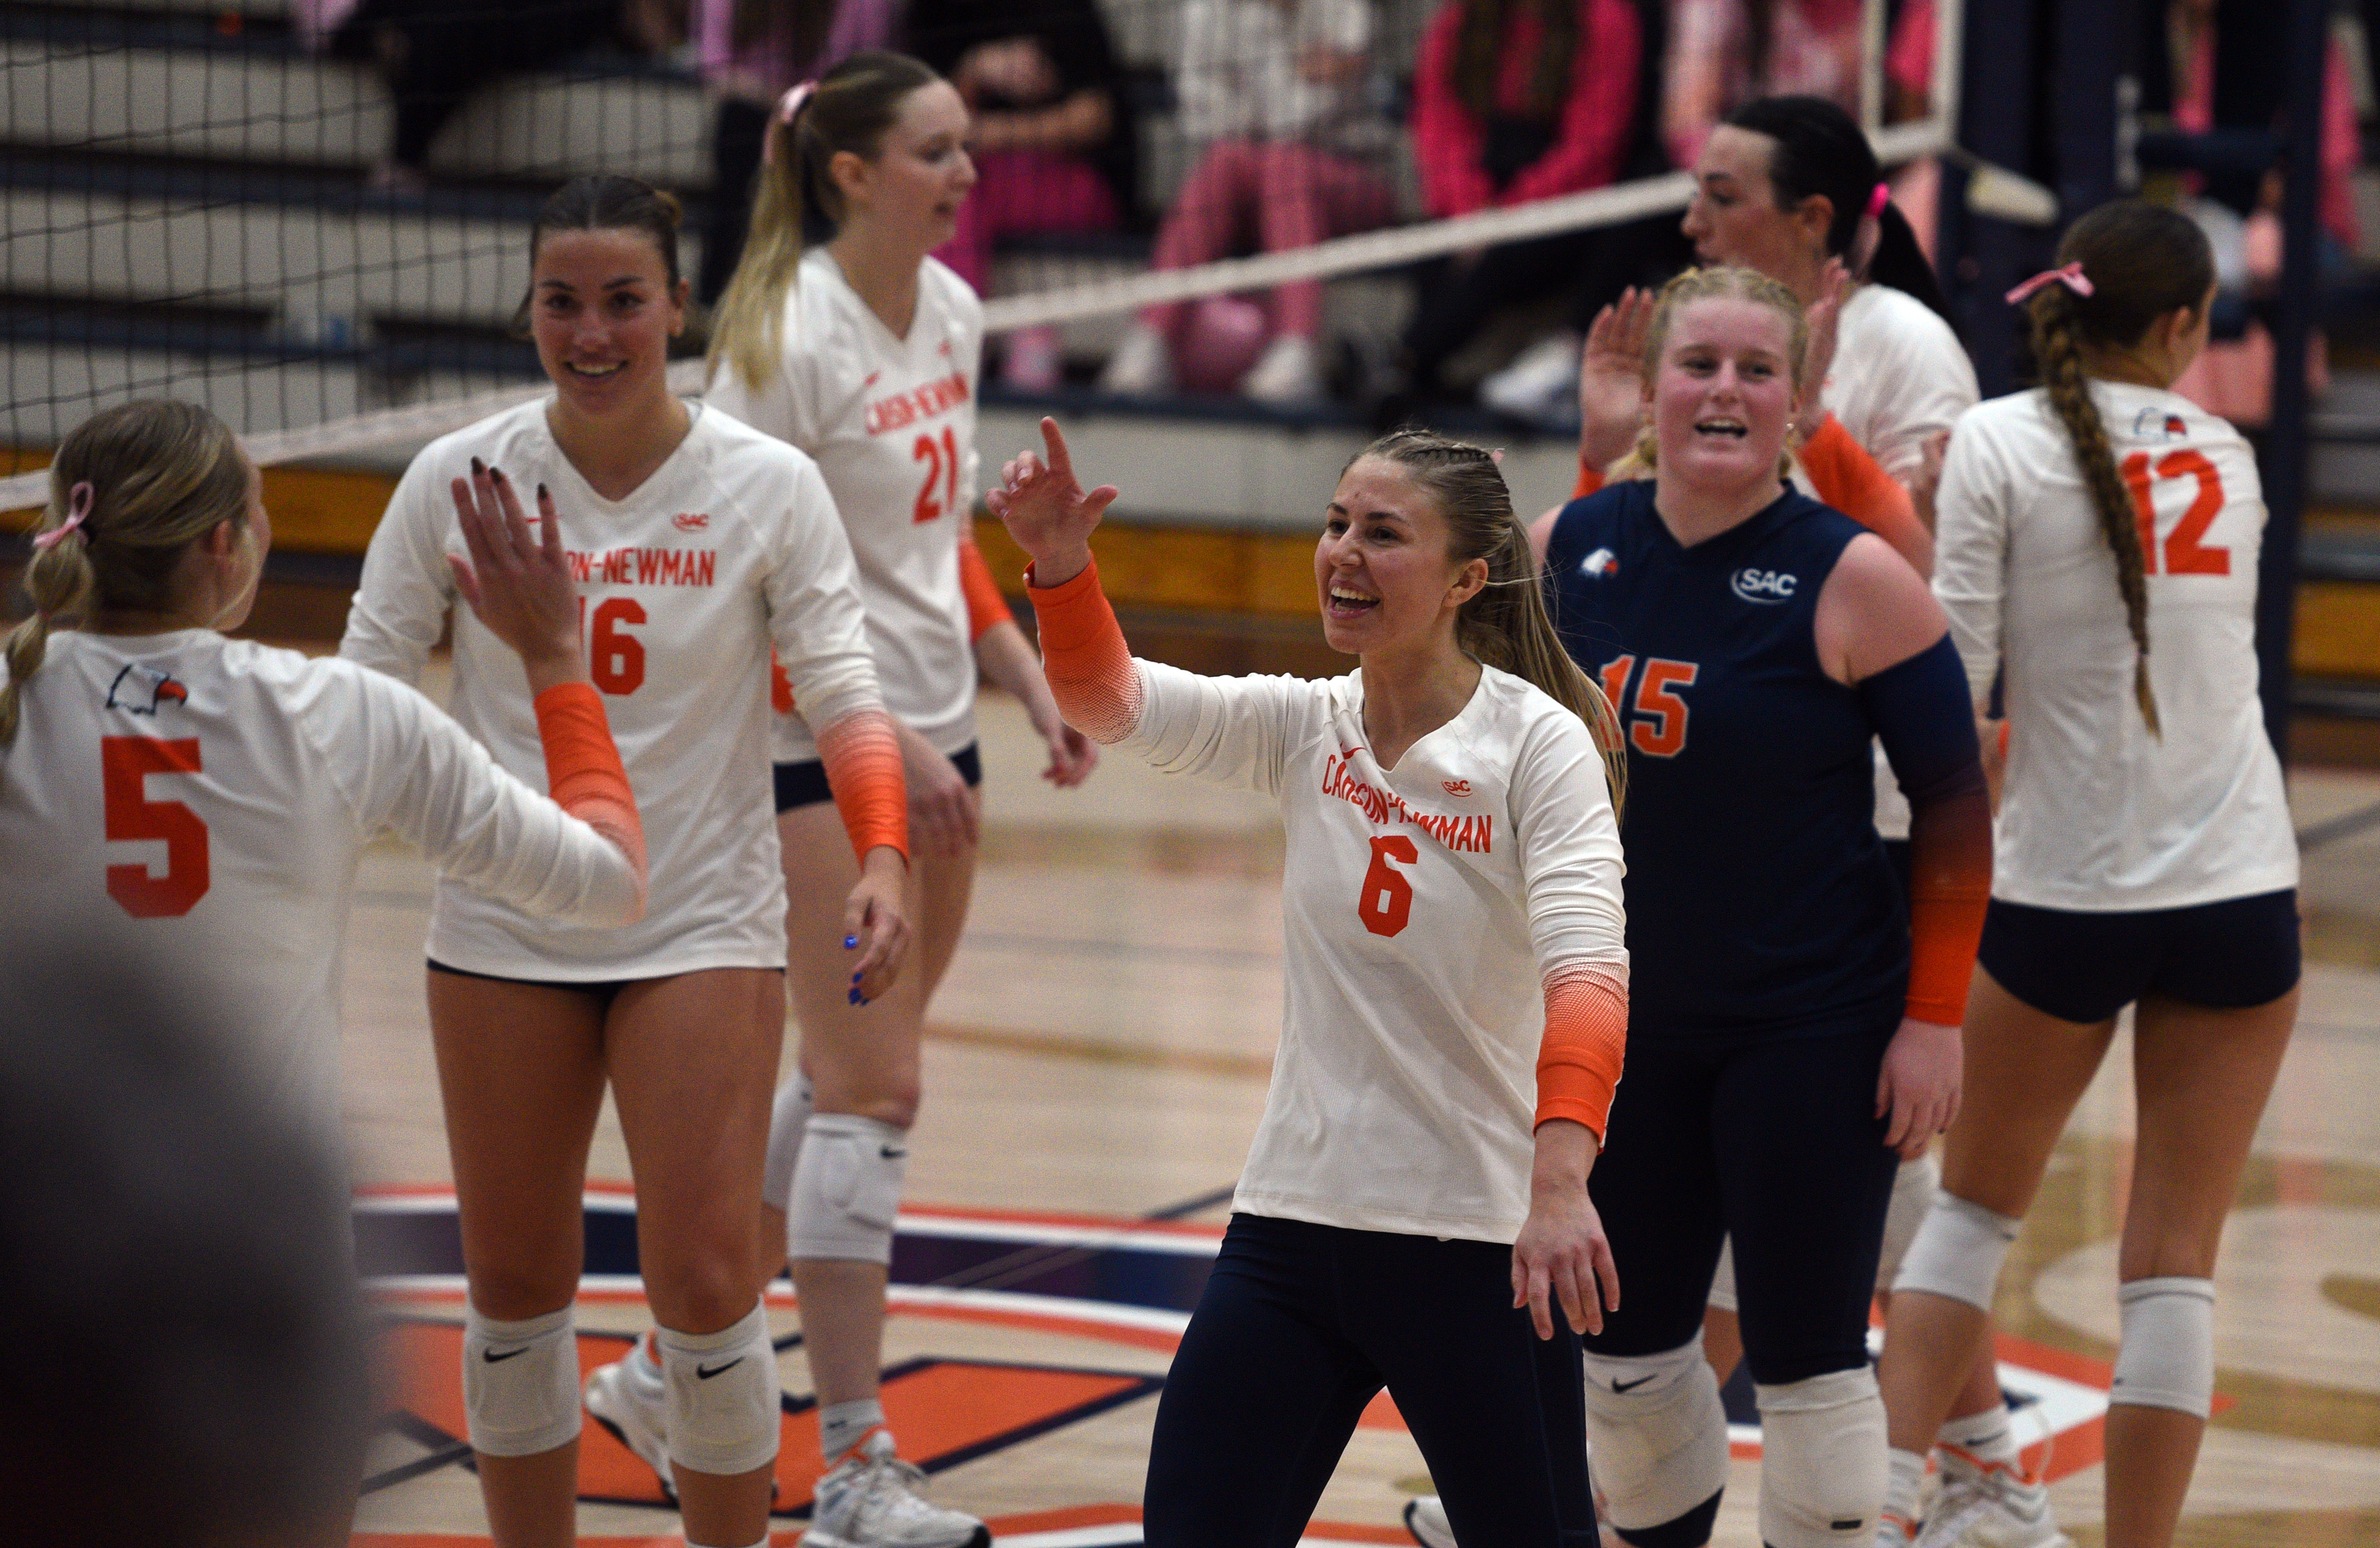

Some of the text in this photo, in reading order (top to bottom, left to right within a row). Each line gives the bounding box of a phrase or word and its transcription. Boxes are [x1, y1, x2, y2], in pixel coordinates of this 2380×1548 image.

[913, 424, 958, 526] 21
[2118, 449, 2231, 577] 12
[1740, 568, 1797, 596] SAC
[1598, 654, 1699, 758] 15
[101, 735, 210, 920] 5
[1444, 779, 1472, 793] SAC
[1358, 834, 1419, 938] 6
